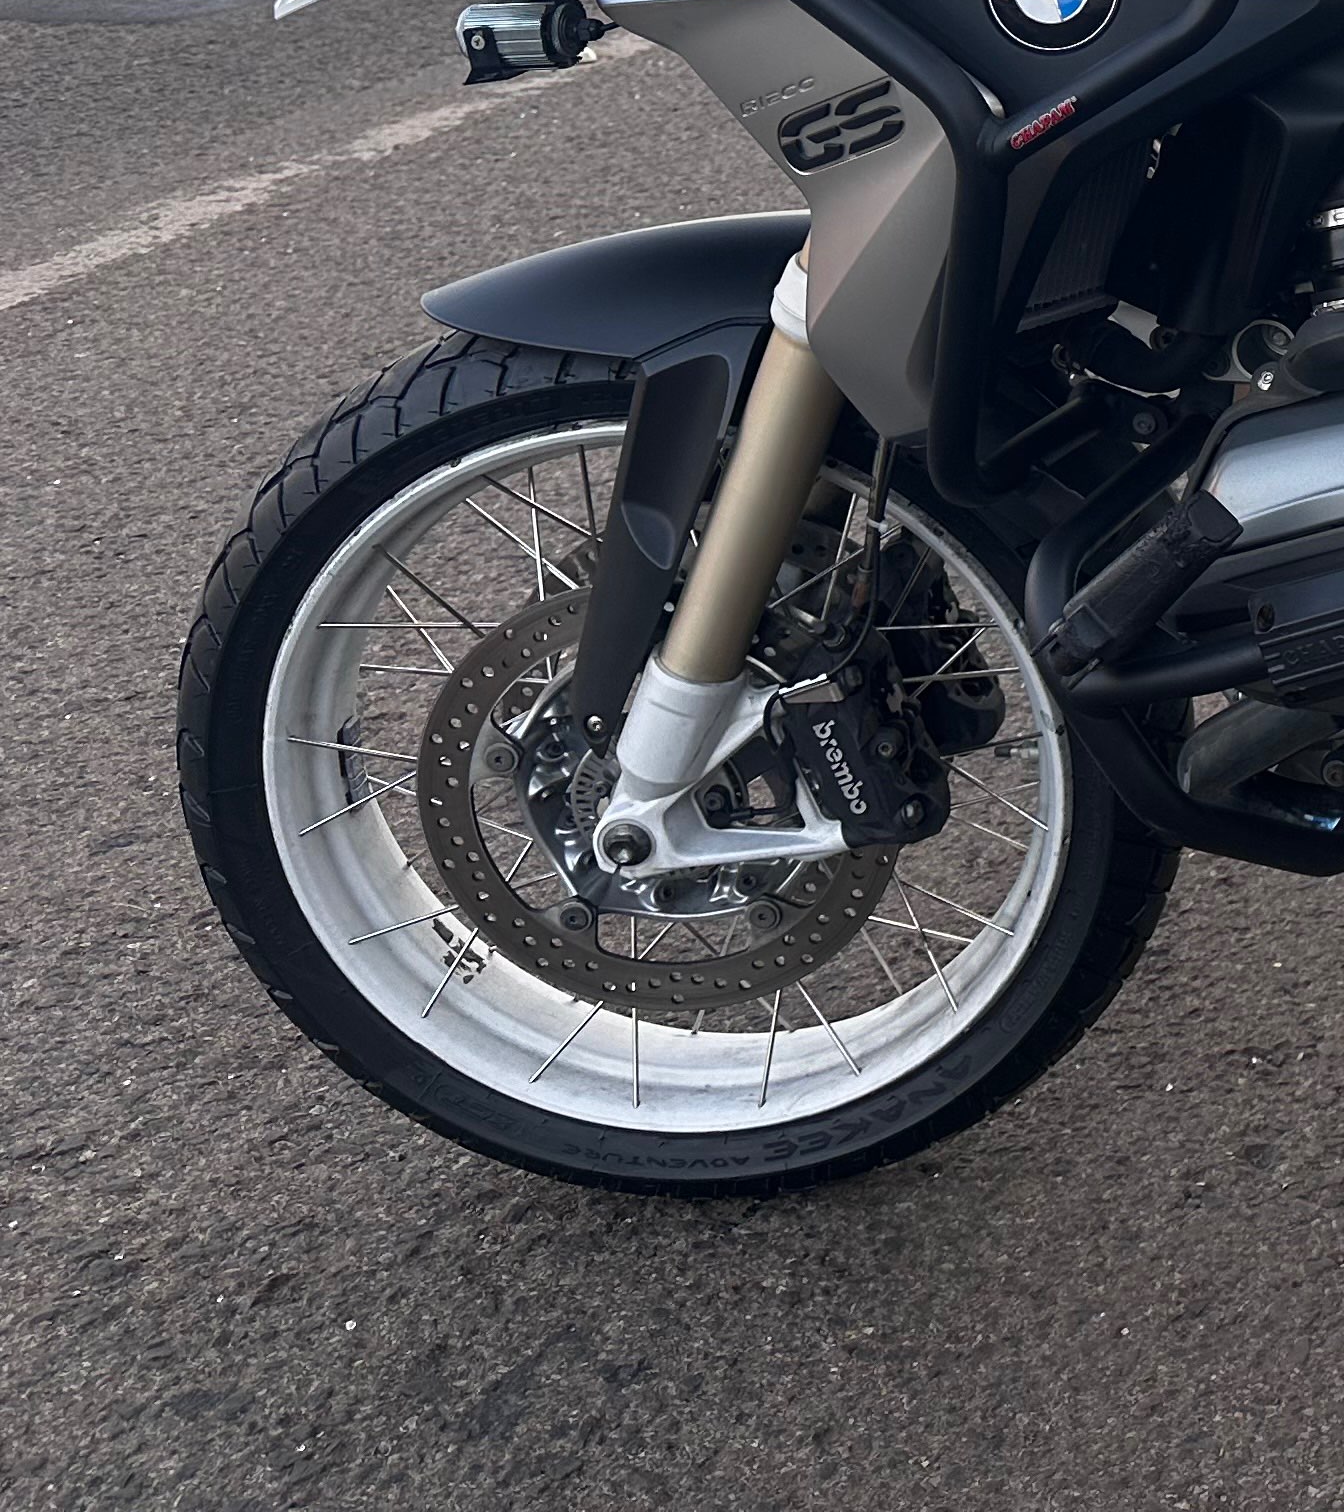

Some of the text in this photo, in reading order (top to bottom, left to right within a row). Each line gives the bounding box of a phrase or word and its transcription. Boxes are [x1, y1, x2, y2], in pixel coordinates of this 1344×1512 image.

[779, 79, 904, 174] GS
[812, 719, 867, 815] brembo
[561, 1054, 973, 1170] ANAKEE ADVENTURE
